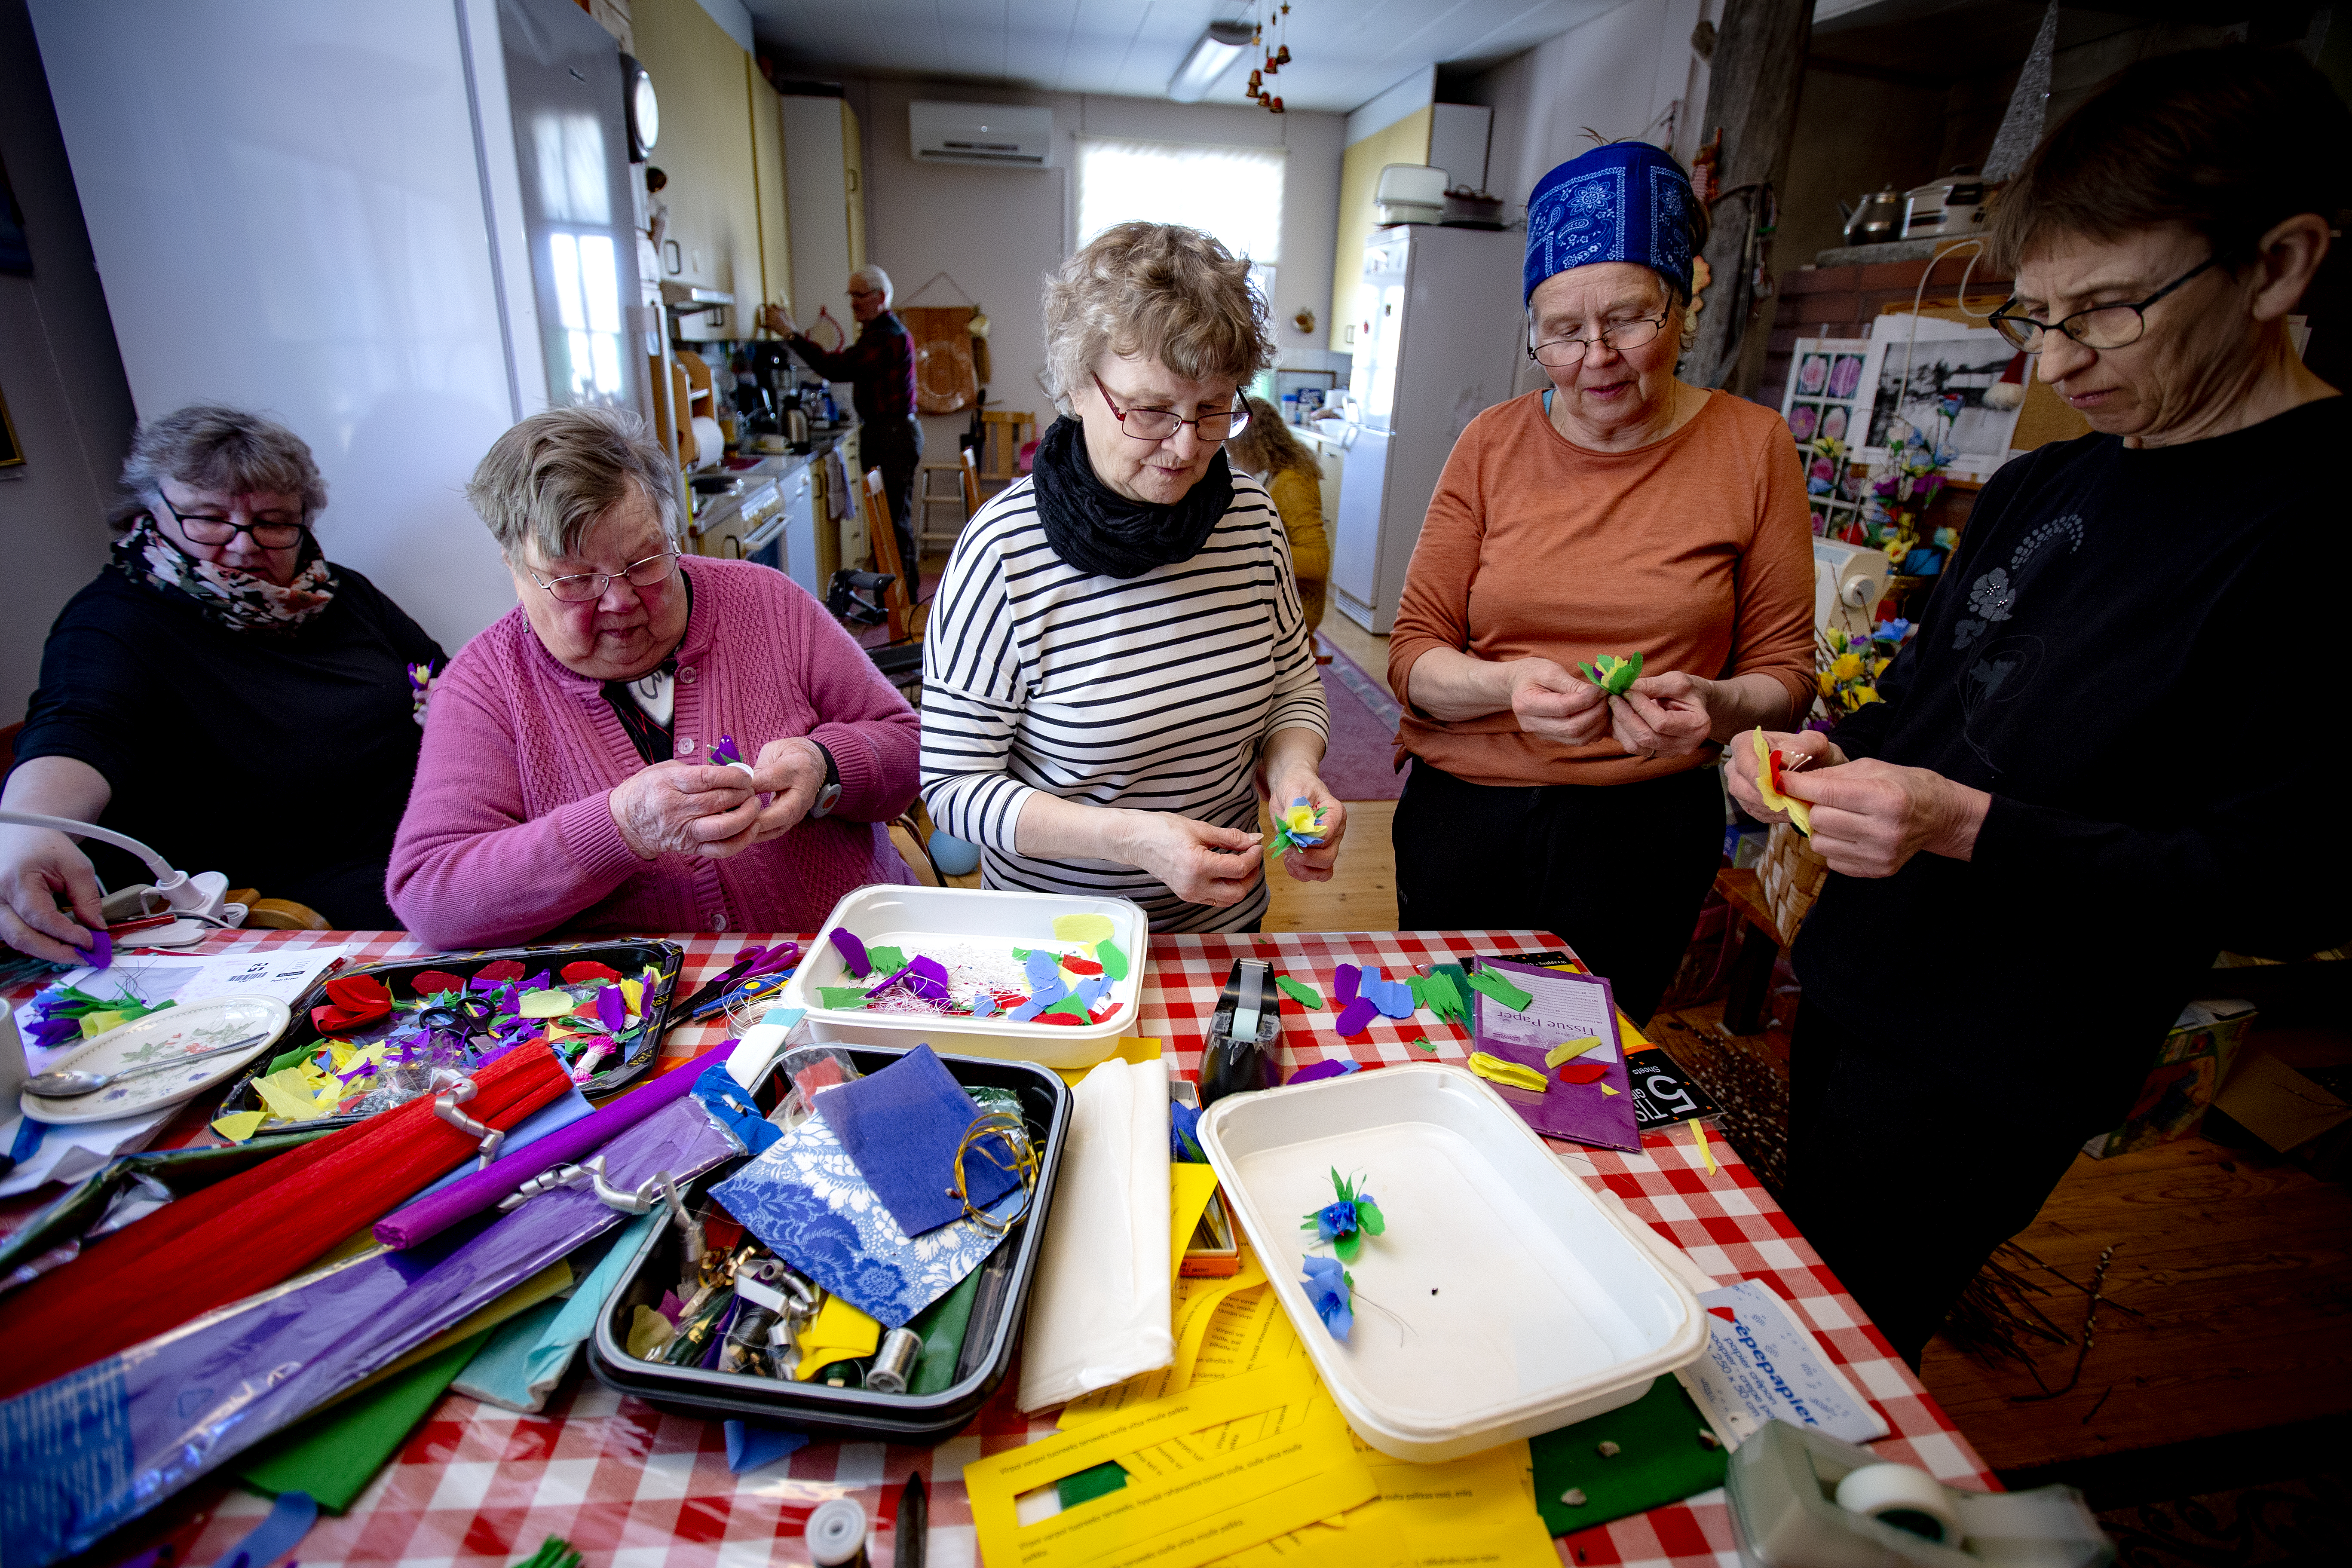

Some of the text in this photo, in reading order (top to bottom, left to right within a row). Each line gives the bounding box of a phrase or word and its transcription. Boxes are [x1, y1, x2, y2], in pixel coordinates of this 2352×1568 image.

[1497, 1011, 1597, 1036] Tissue Paper
[1646, 1075, 1697, 1113] 5
[1256, 1321, 1270, 1345] rahavuotta
[1266, 1307, 1275, 1321] toivon
[1712, 1351, 1732, 1375] 250
[1727, 1375, 1736, 1383] x
[1734, 1383, 1750, 1401] 50
[1746, 1400, 1761, 1418] cm
[1724, 1335, 1778, 1406] papier crêpon
[1734, 1318, 1819, 1426] rêpepapier
[1739, 1373, 1763, 1404] crepe
[999, 1403, 1191, 1476] Virpoi varpoi tuoreeks terveeks teille vitsa miulle palkka.
[1017, 1536, 1042, 1551] Virpoi
[1067, 1514, 1102, 1533] tuoreeks
[1162, 1479, 1203, 1498] rahavuotta
[1246, 1456, 1265, 1469] siulle
[1265, 1450, 1281, 1462] vitsa
[1281, 1442, 1303, 1456] miulle
